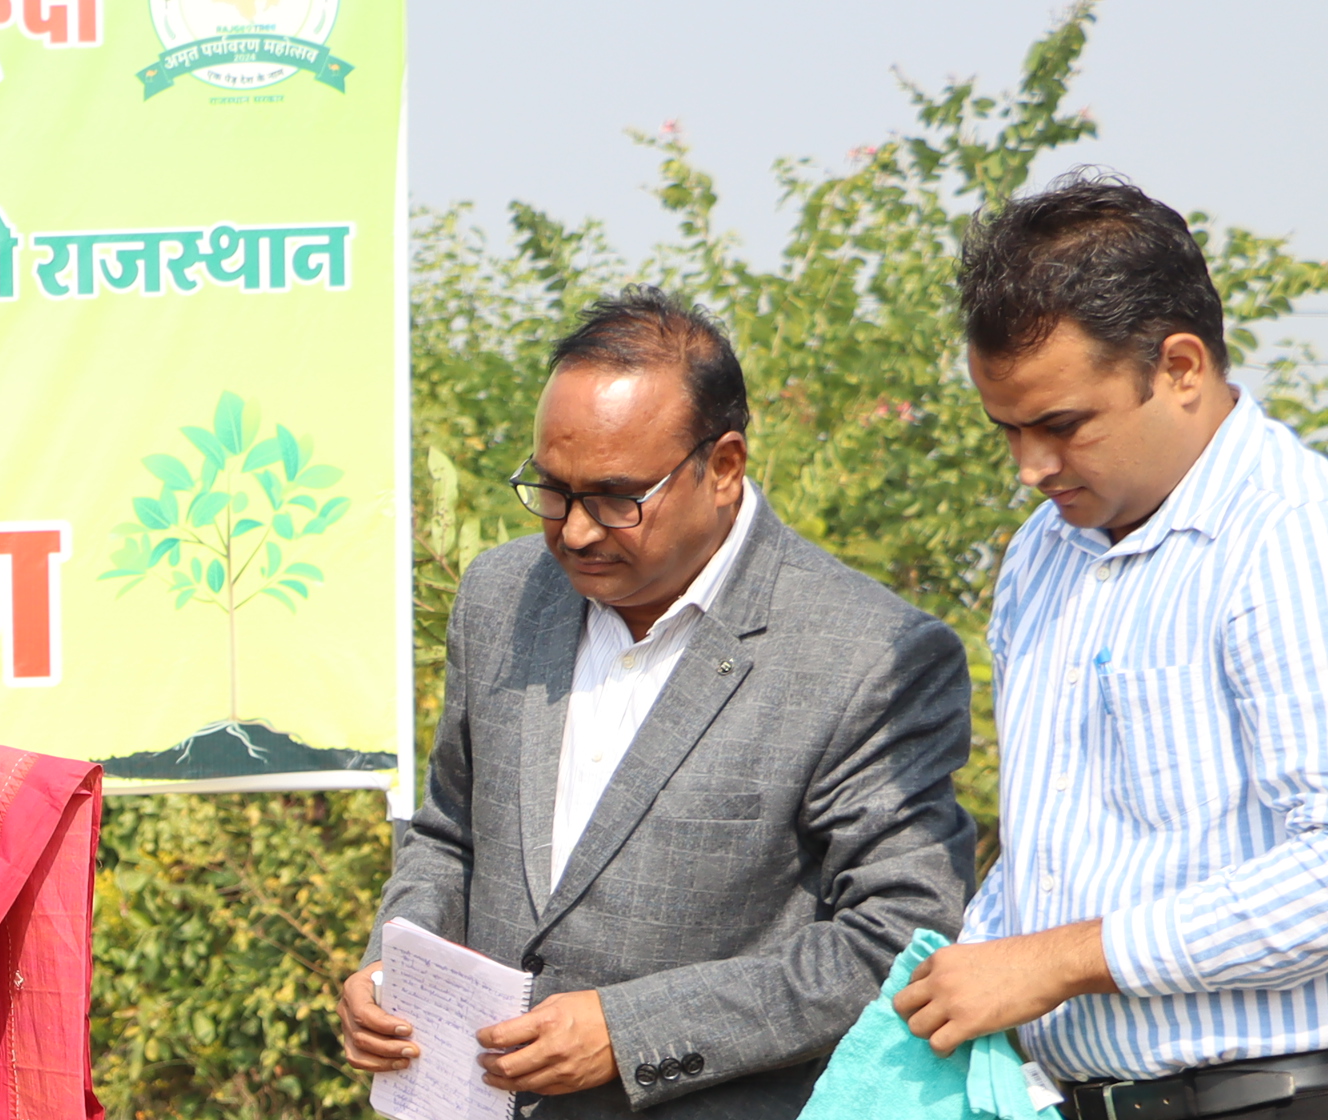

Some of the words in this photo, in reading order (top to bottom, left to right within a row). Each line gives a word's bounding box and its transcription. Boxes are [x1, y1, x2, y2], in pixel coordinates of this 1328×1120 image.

[163, 45, 199, 69] अमृत
[201, 36, 261, 57] पर्यावरण
[263, 36, 319, 63] महोत्सव
[233, 53, 256, 62] 2024
[35, 225, 350, 297] राजस्थान
